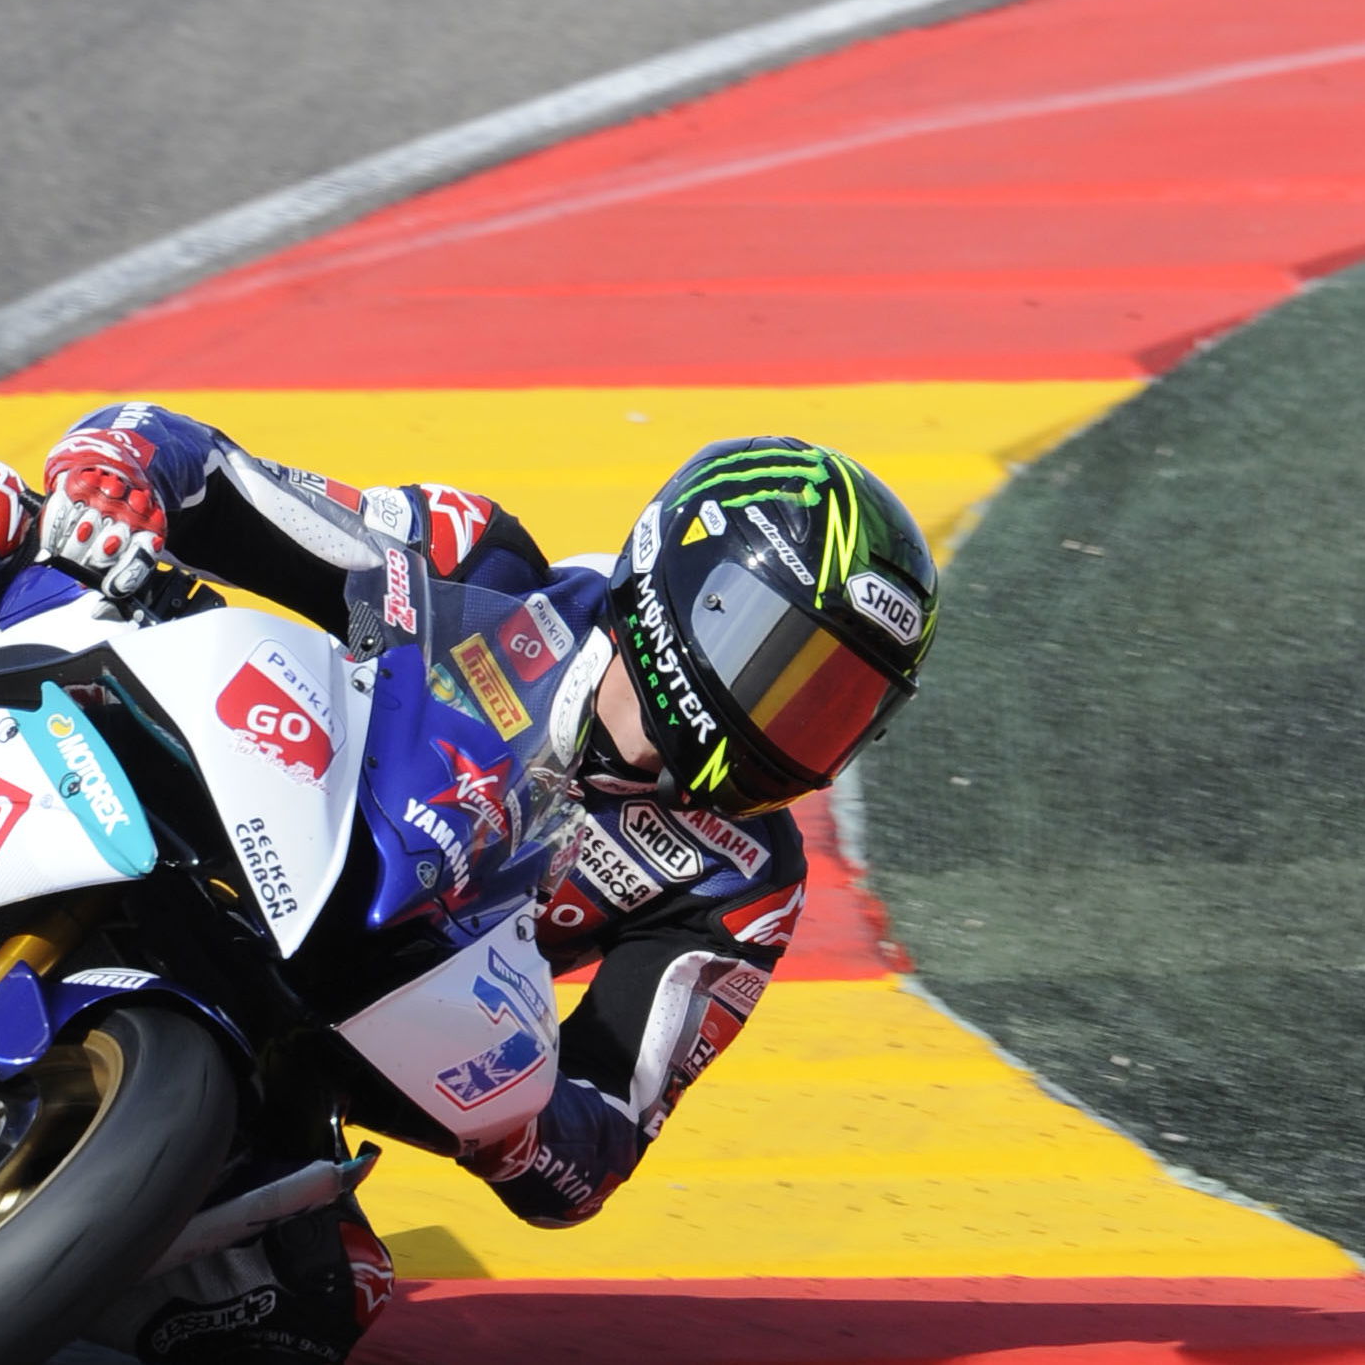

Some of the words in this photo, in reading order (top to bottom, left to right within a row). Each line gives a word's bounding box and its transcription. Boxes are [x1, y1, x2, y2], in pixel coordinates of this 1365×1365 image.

[534, 600, 566, 650] Parkin
[860, 581, 917, 637] SHOEI
[509, 633, 542, 659] GO
[626, 614, 680, 726] ENERGY
[637, 573, 717, 745] MONSTER
[461, 643, 523, 730] PIRELLI
[246, 703, 312, 743] GO
[56, 732, 131, 837] MOTOREX
[456, 772, 506, 831] Virgin
[249, 817, 298, 914] BECKER
[402, 797, 470, 898] YAMAHA
[628, 809, 693, 873] SHOEI
[681, 810, 761, 869] AMAHA
[236, 823, 284, 920] CARBON
[580, 847, 642, 907] ARBON
[549, 903, 585, 928] O
[61, 967, 161, 991] PIRELLI
[534, 1144, 593, 1206] arkin
